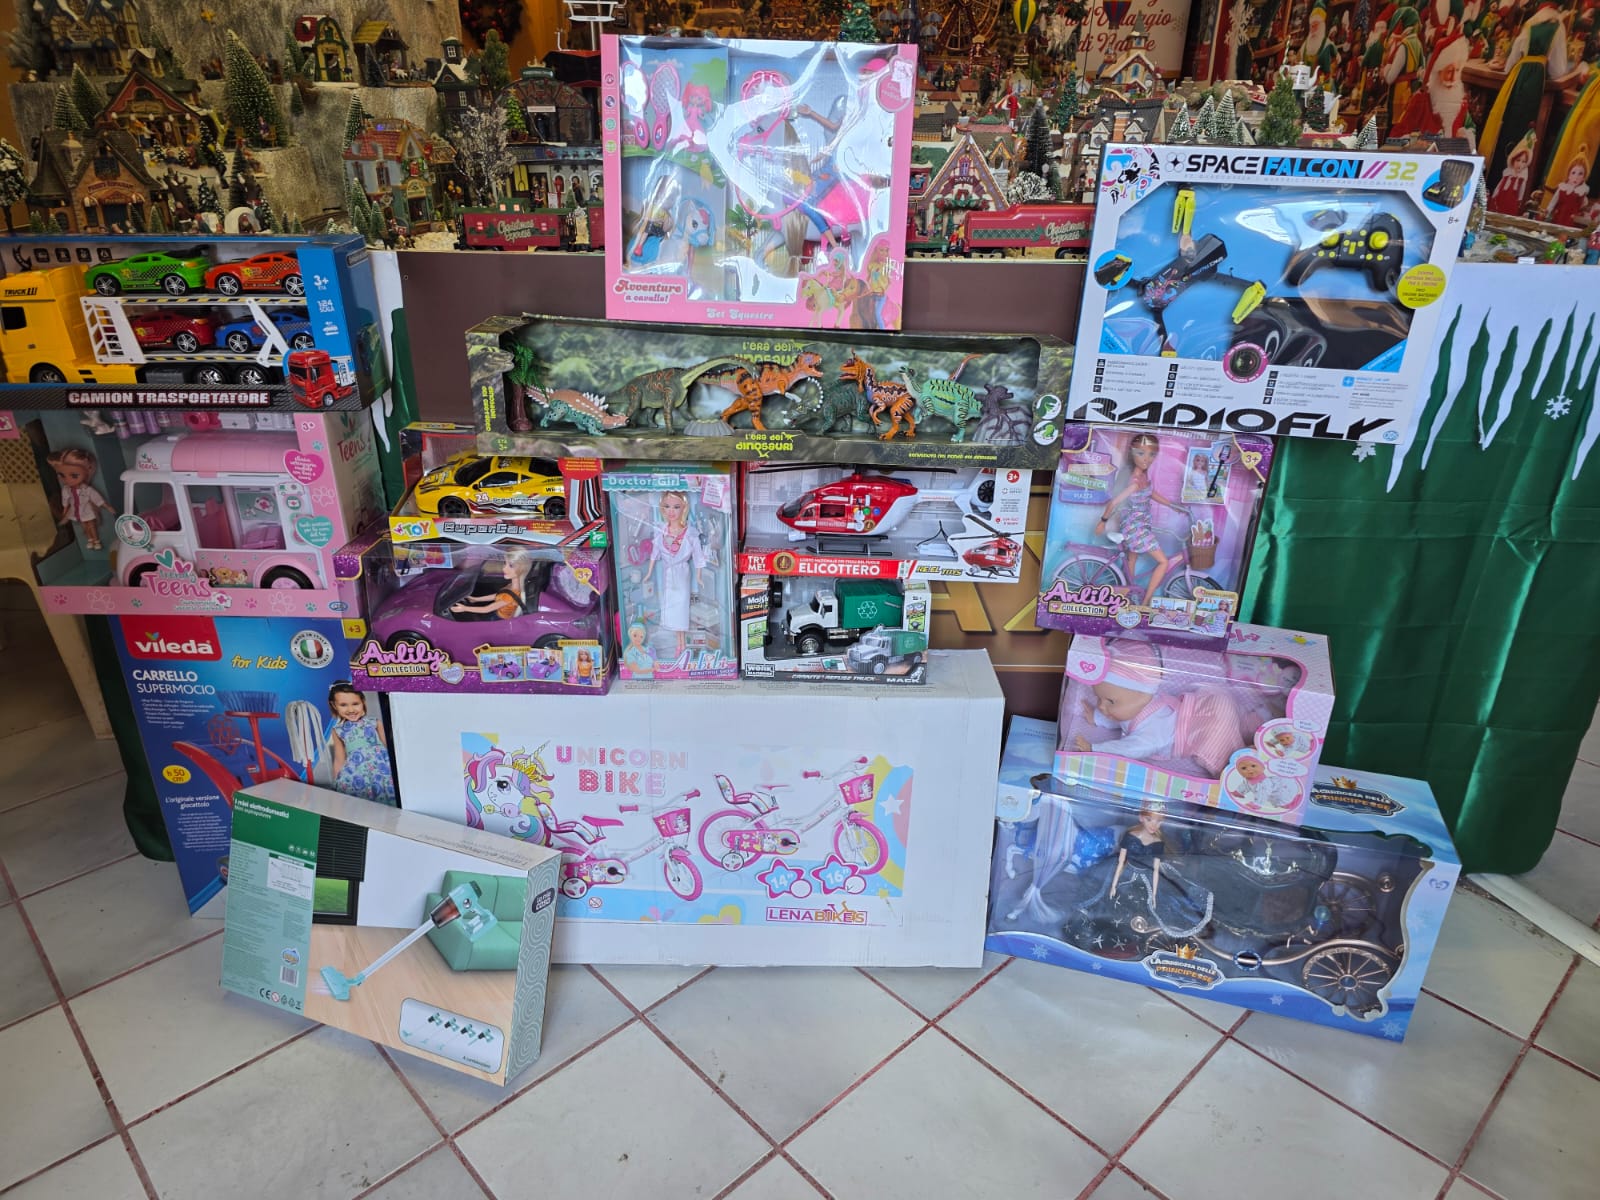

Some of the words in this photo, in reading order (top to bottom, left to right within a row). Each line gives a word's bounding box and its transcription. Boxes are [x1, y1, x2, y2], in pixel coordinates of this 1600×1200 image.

[1186, 154, 1261, 175] SPACE
[1263, 156, 1359, 179] FALCON
[313, 275, 329, 286] 3+
[615, 279, 682, 293] Avventure
[633, 293, 669, 303] cavallo!
[706, 308, 725, 319] Set
[729, 309, 774, 320] Equestre
[774, 341, 791, 351] dei
[68, 392, 133, 404] CAMION
[136, 392, 269, 404] TRASPORTATORE
[1072, 397, 1396, 441] RADIOFLY
[337, 440, 365, 461] Teens
[736, 441, 793, 452] dinosauri
[1245, 454, 1259, 463] 3+
[608, 475, 651, 486] Doctor
[657, 475, 681, 487] Girl
[476, 493, 489, 502] 24
[443, 522, 527, 535] SuperCar
[577, 569, 592, 579] 3+
[798, 563, 880, 576] ELICOTTERO
[143, 574, 212, 597] Teens
[1042, 580, 1127, 615] Anlily
[1061, 605, 1104, 614] COLLECTION
[348, 625, 361, 633] +3
[135, 638, 214, 654] vileda
[232, 654, 252, 669] for
[256, 655, 288, 669] Kids
[359, 641, 446, 672] Anlily
[132, 669, 198, 682] CARRELLO
[381, 665, 426, 673] COLLECTION
[136, 683, 216, 695] SUPERMOCIO
[556, 745, 687, 768] UNICORN
[174, 769, 185, 777] 50
[578, 769, 664, 795] BIKE
[165, 795, 194, 804] L'originale
[772, 873, 793, 889] 14"
[828, 868, 850, 884] 16"
[769, 908, 865, 923] LENABIKES
[1155, 966, 1214, 983] PRINCIPESSE
